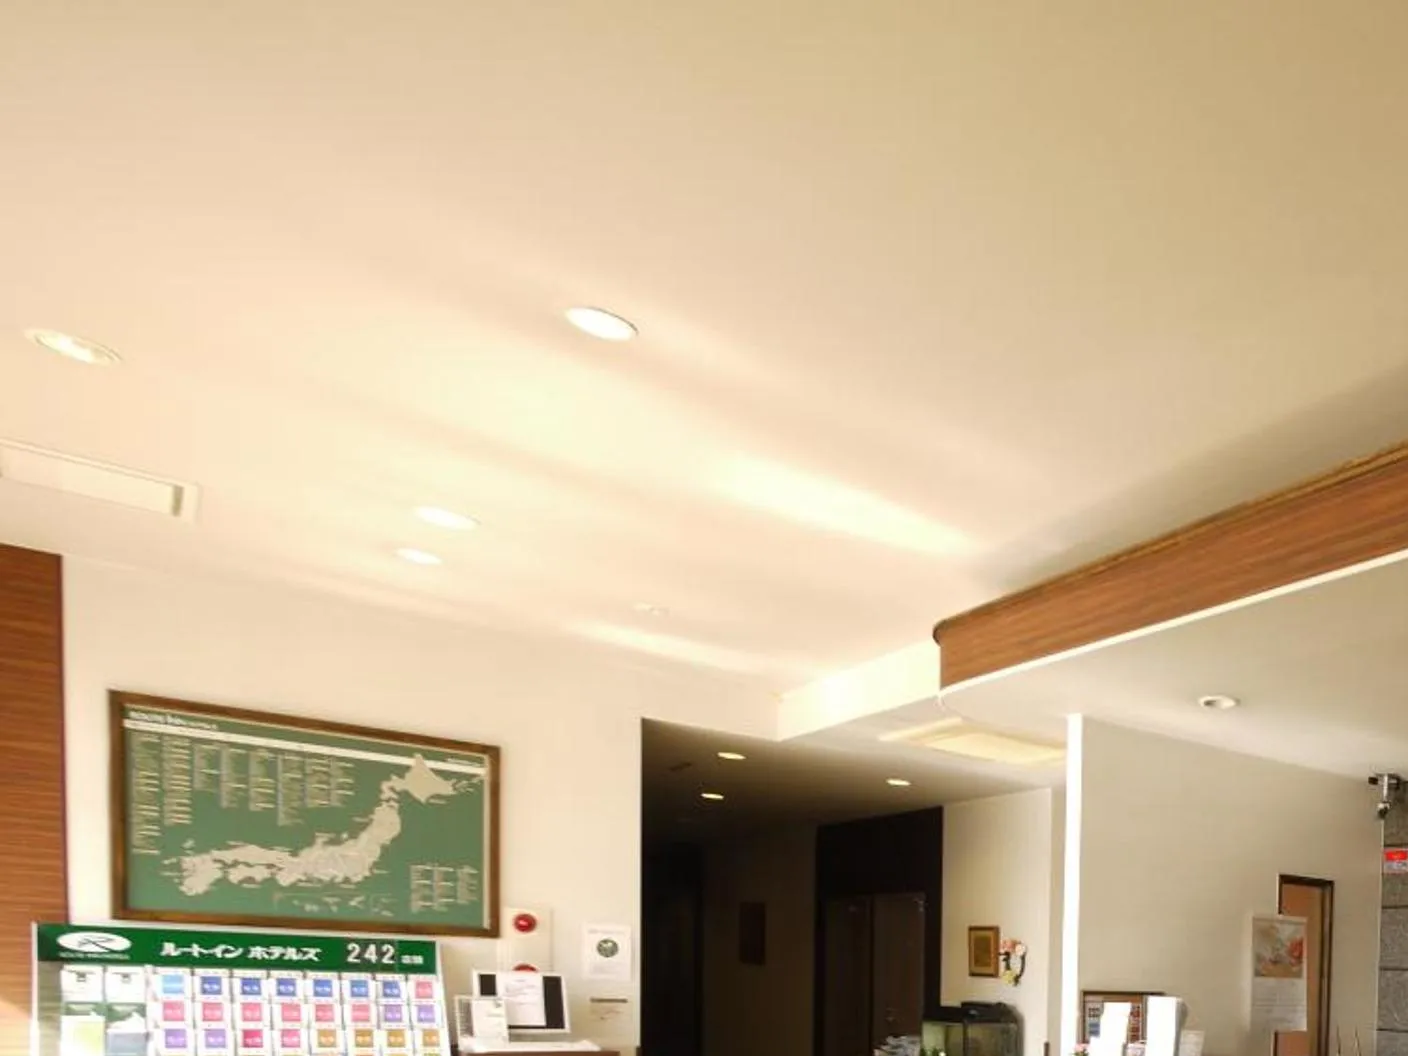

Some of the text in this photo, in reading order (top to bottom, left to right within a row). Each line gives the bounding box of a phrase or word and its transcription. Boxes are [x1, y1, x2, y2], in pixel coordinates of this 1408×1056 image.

[160, 941, 243, 959] ルートイン
[248, 945, 322, 962] ホテルズ
[346, 942, 396, 965] 242
